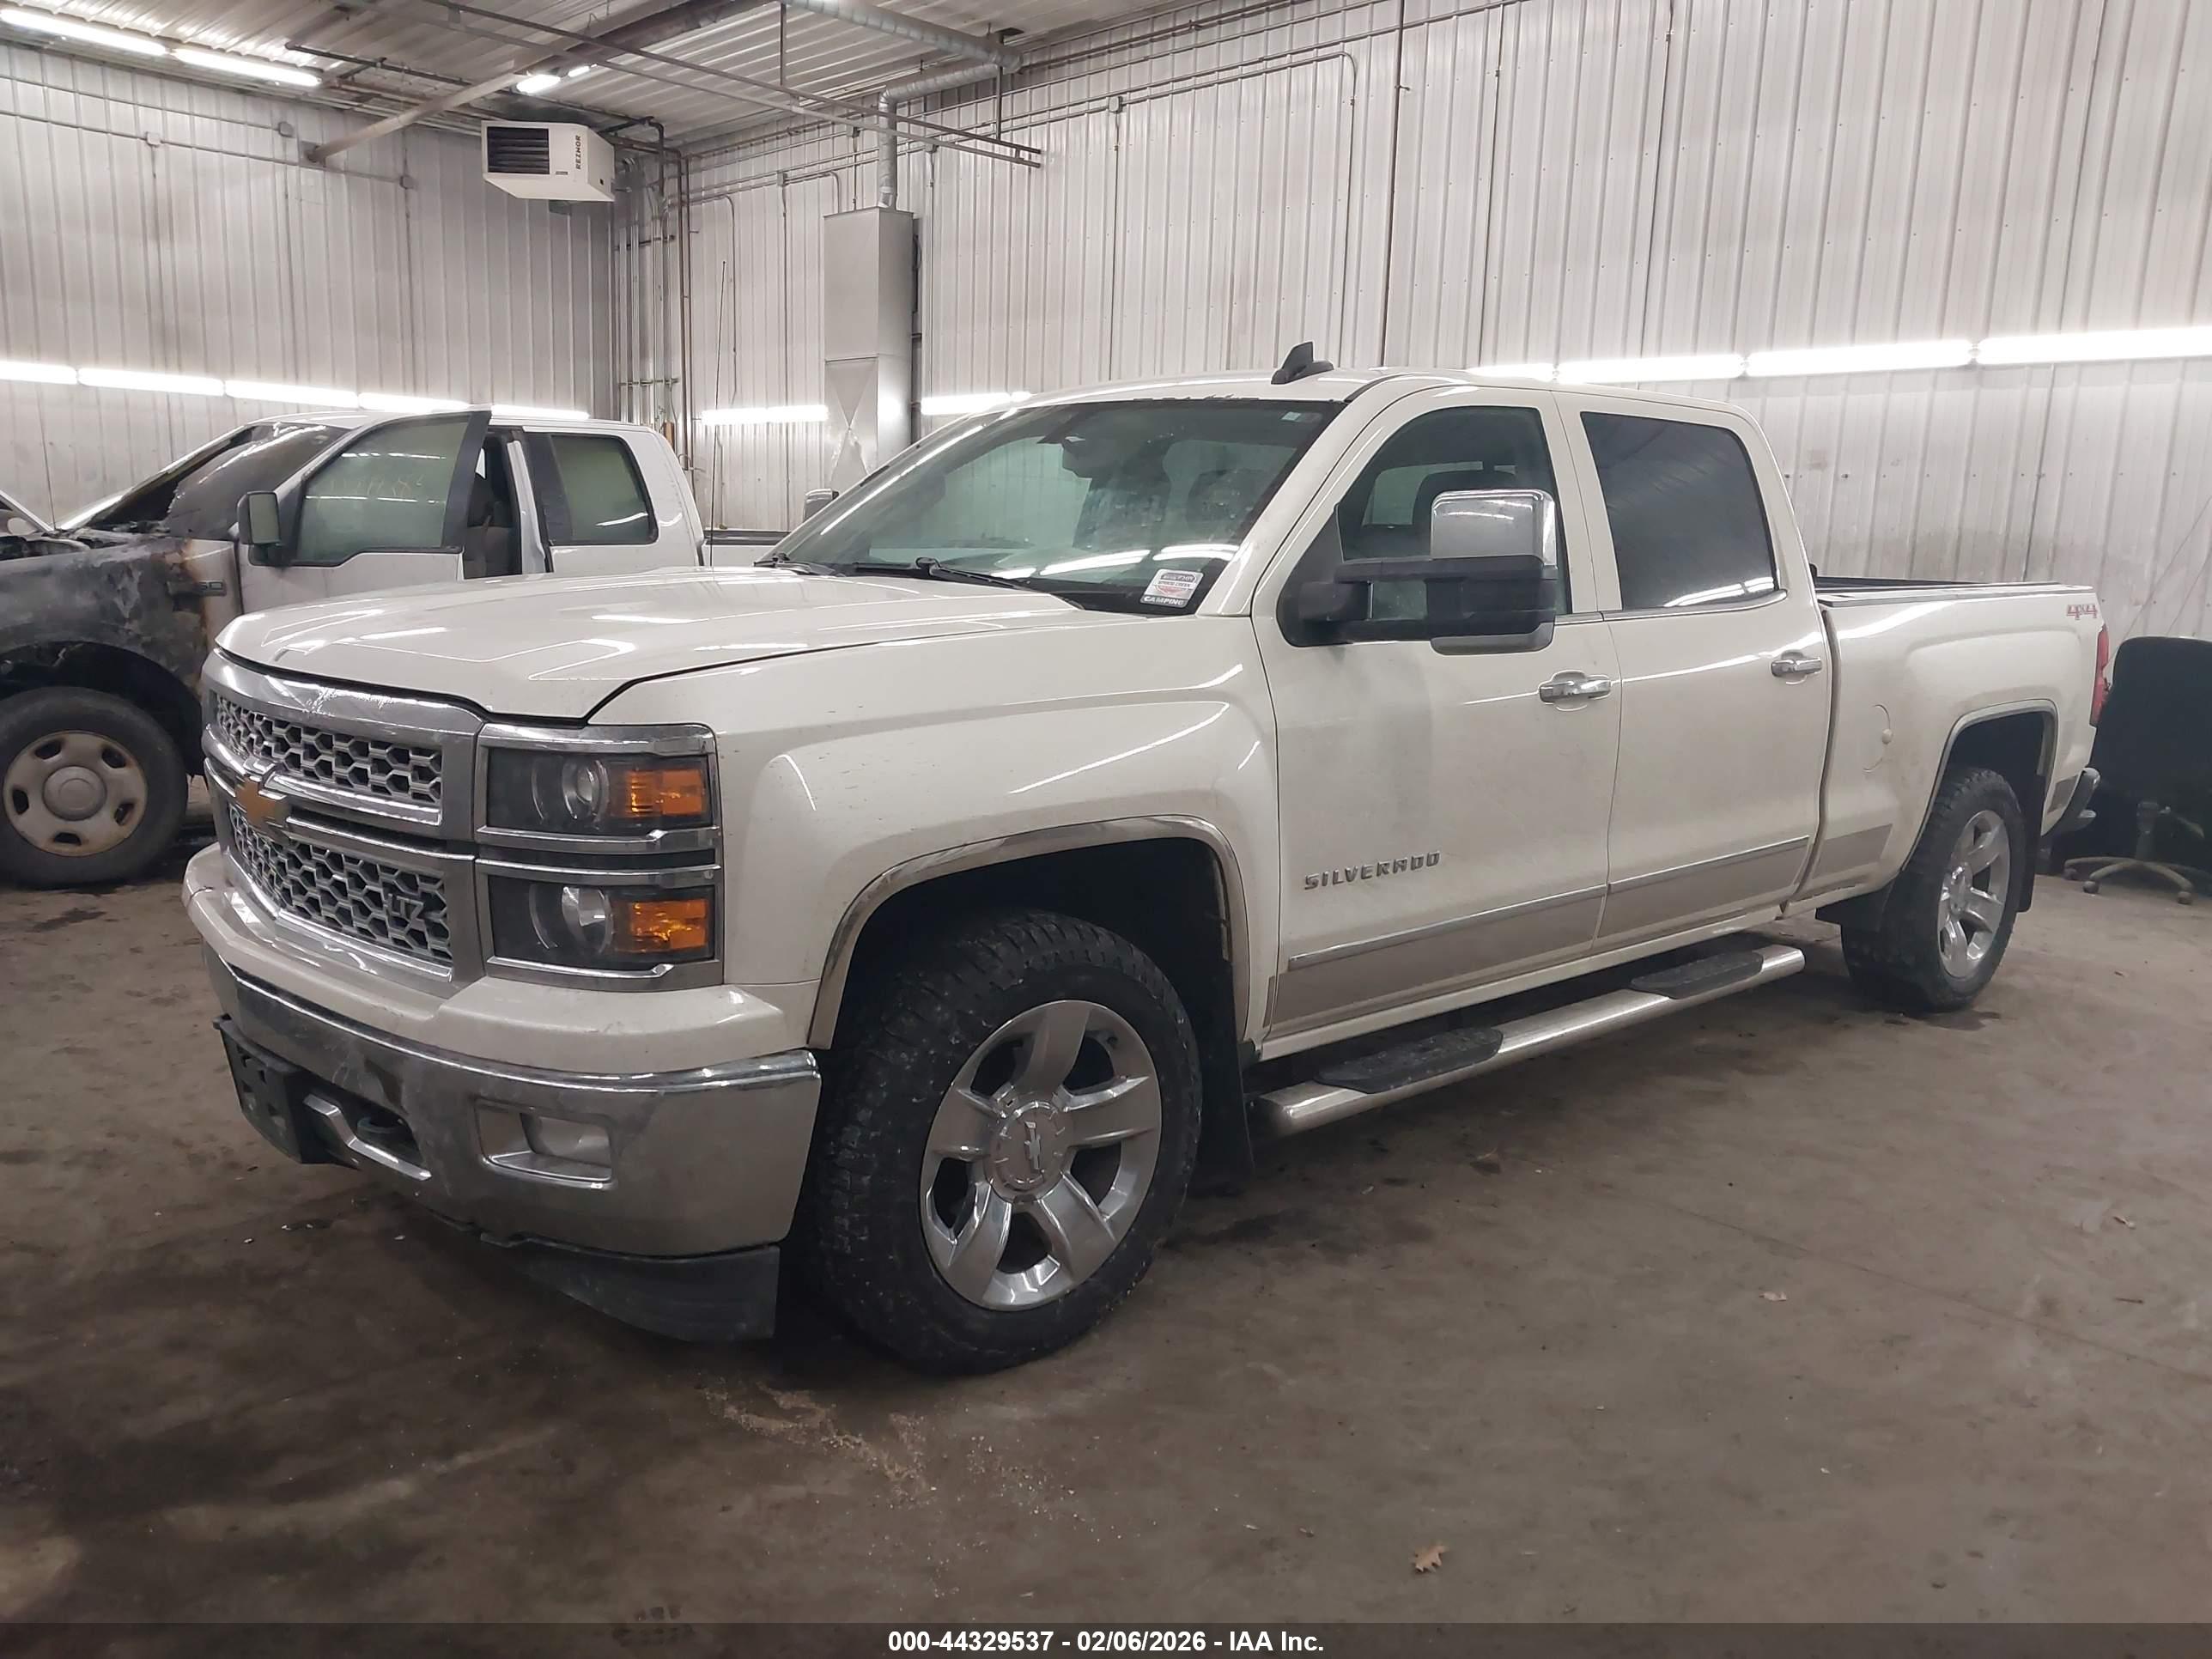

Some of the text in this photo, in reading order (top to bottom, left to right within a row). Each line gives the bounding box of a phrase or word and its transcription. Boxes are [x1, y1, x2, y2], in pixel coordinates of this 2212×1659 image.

[1143, 595, 1184, 606] CAMPING
[1304, 850, 1441, 890] SILVERADO
[387, 892, 425, 927] LTZ
